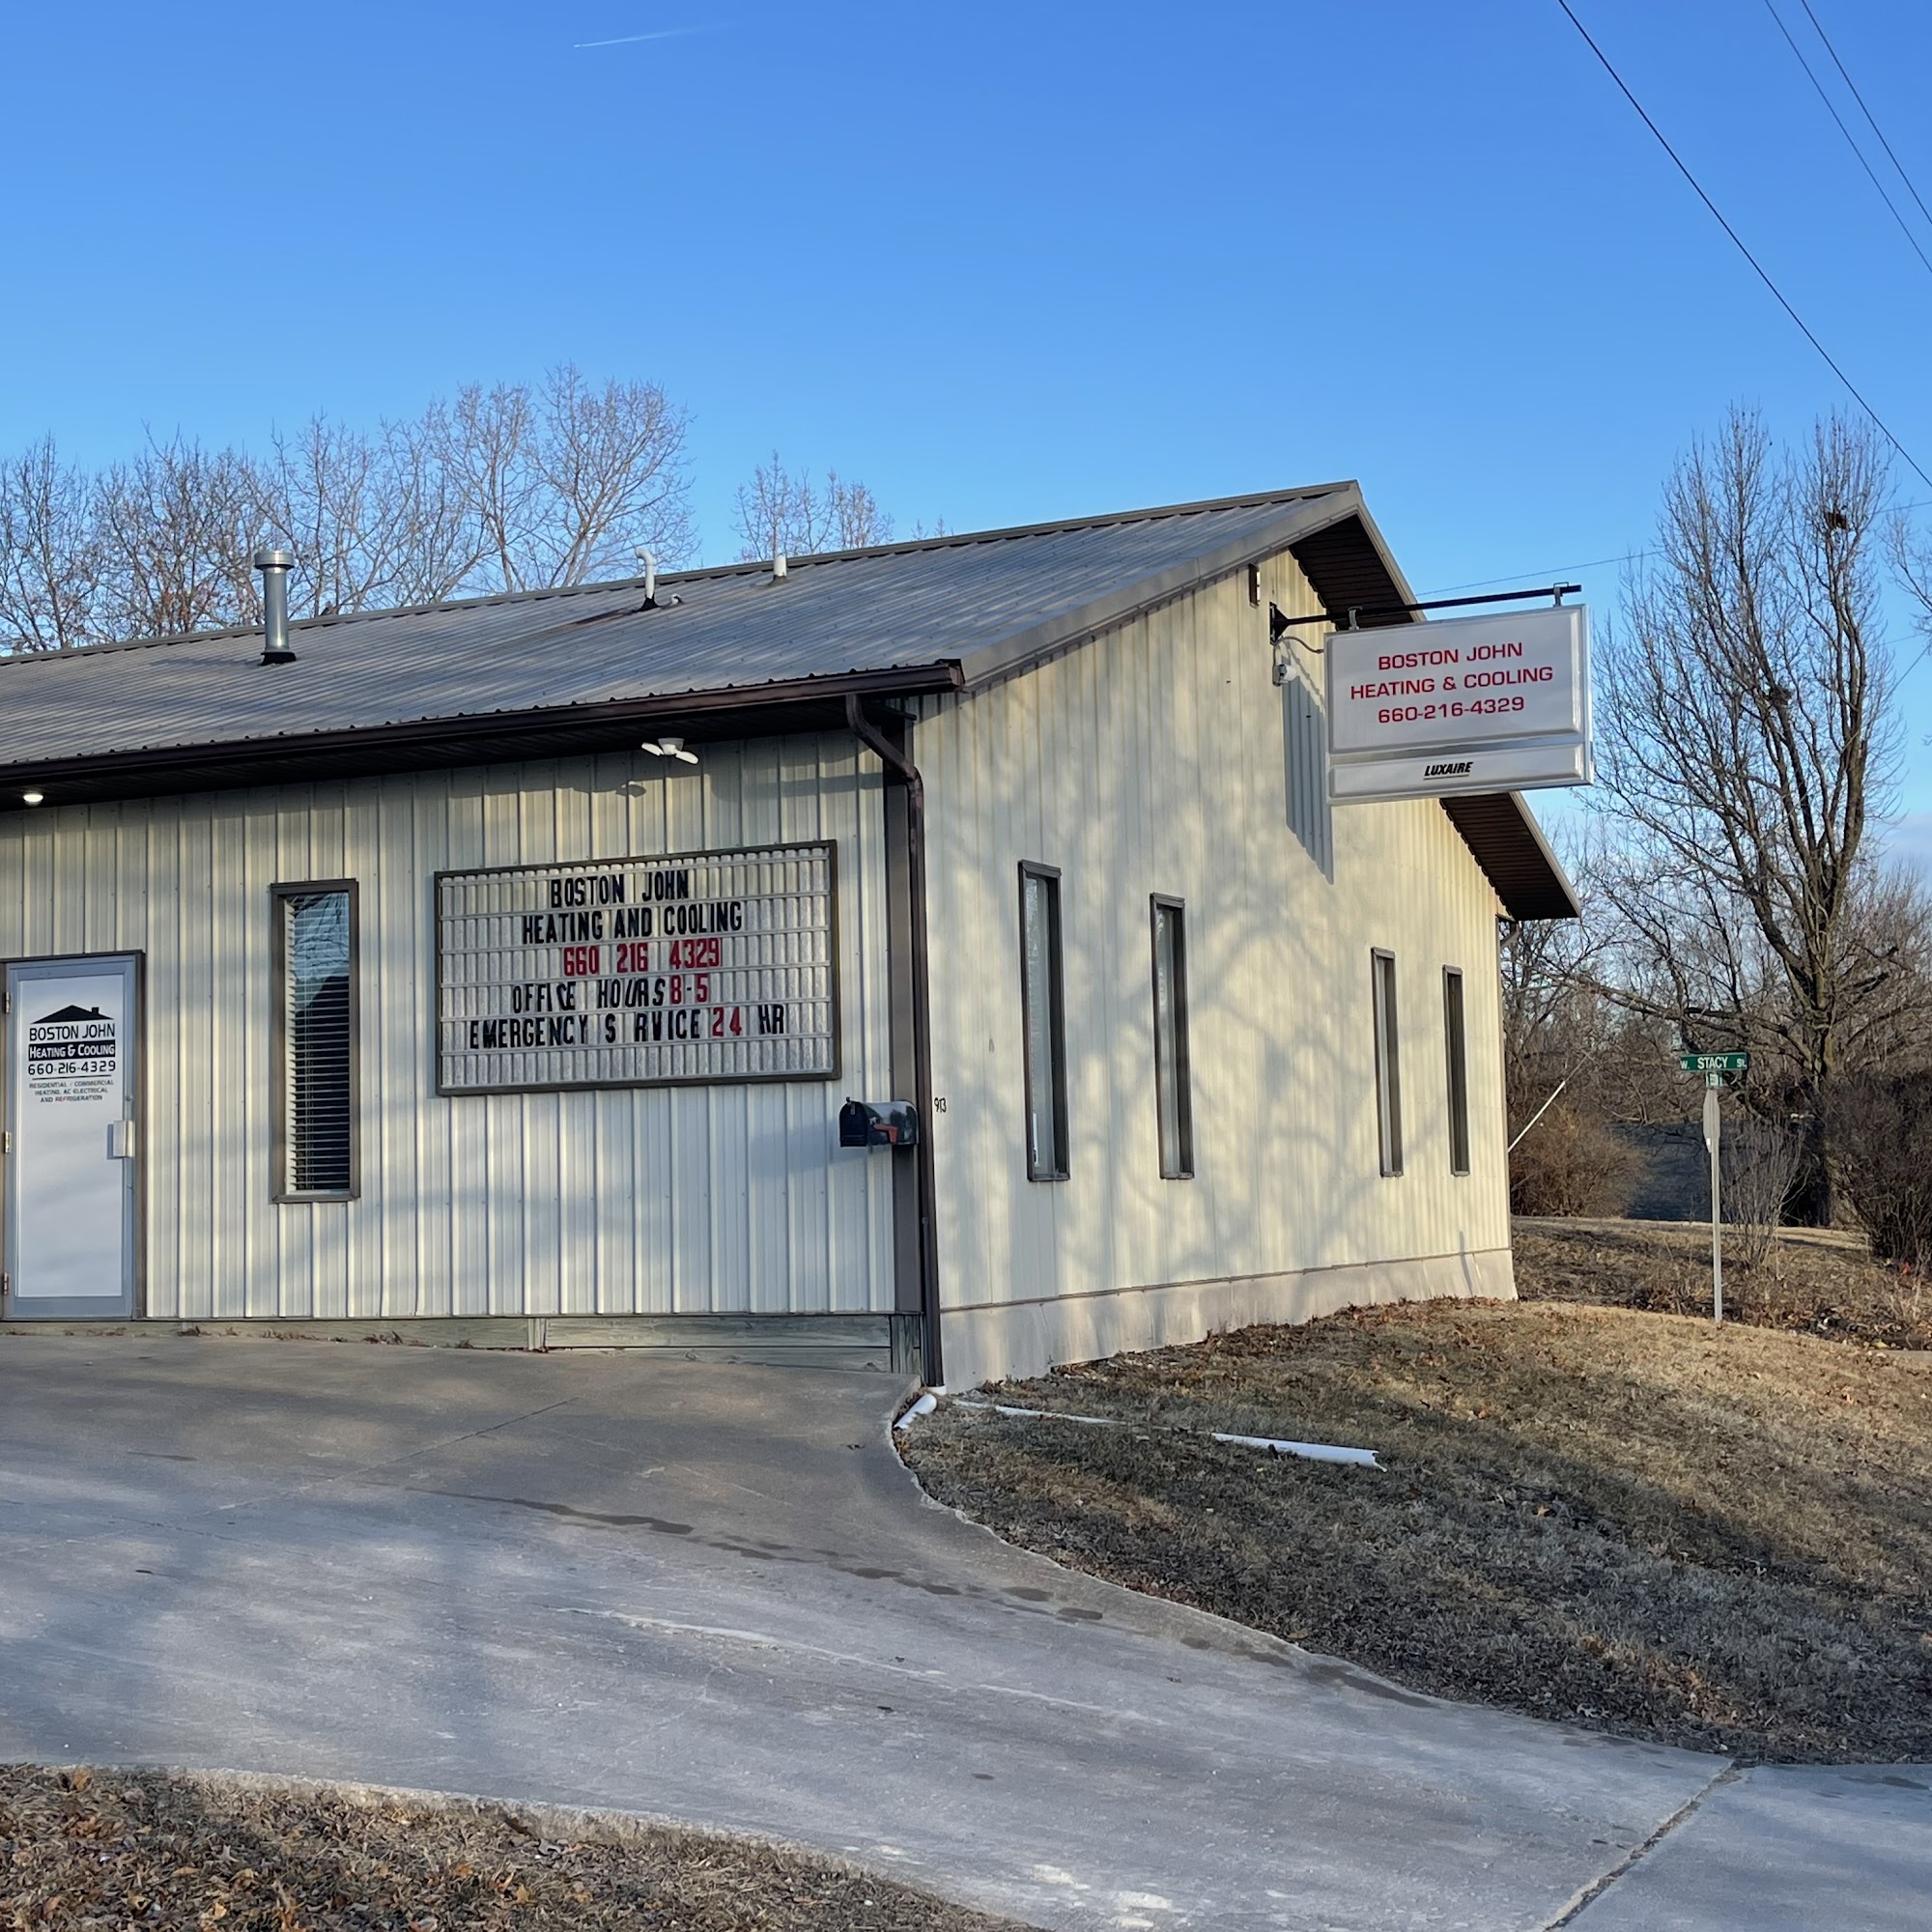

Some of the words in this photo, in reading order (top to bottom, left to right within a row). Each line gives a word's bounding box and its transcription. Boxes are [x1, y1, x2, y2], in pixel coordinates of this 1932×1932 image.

[1378, 648, 1459, 670] BOSTON
[1466, 641, 1523, 662] JOHN
[1350, 678, 1435, 700] HEATING
[1442, 676, 1457, 691] &
[1463, 666, 1553, 689] COOLING
[1378, 696, 1524, 724] 660-216-4329
[1423, 761, 1474, 777] LUXAIRE
[551, 874, 625, 908] BOSTON
[641, 869, 689, 902] JOHN
[522, 910, 603, 945] HEATING
[614, 907, 653, 939] AND
[664, 901, 742, 936] COOLING
[563, 945, 600, 977] 660
[616, 942, 648, 974] 216
[668, 938, 721, 970] 4329
[512, 980, 577, 1014] OFFICE
[597, 978, 667, 1009] HOURS
[669, 973, 709, 1005] 8-5
[29, 1026, 79, 1041] BOSTON
[82, 1023, 115, 1038] JOHN
[469, 1014, 588, 1050] EMERGENCY
[711, 1006, 742, 1037] 24
[758, 1004, 784, 1035] HR
[67, 1044, 75, 1056] &
[1697, 1056, 1728, 1069] STACY
[28, 1060, 116, 1075] 660-216-4329
[934, 1097, 947, 1113] 913
